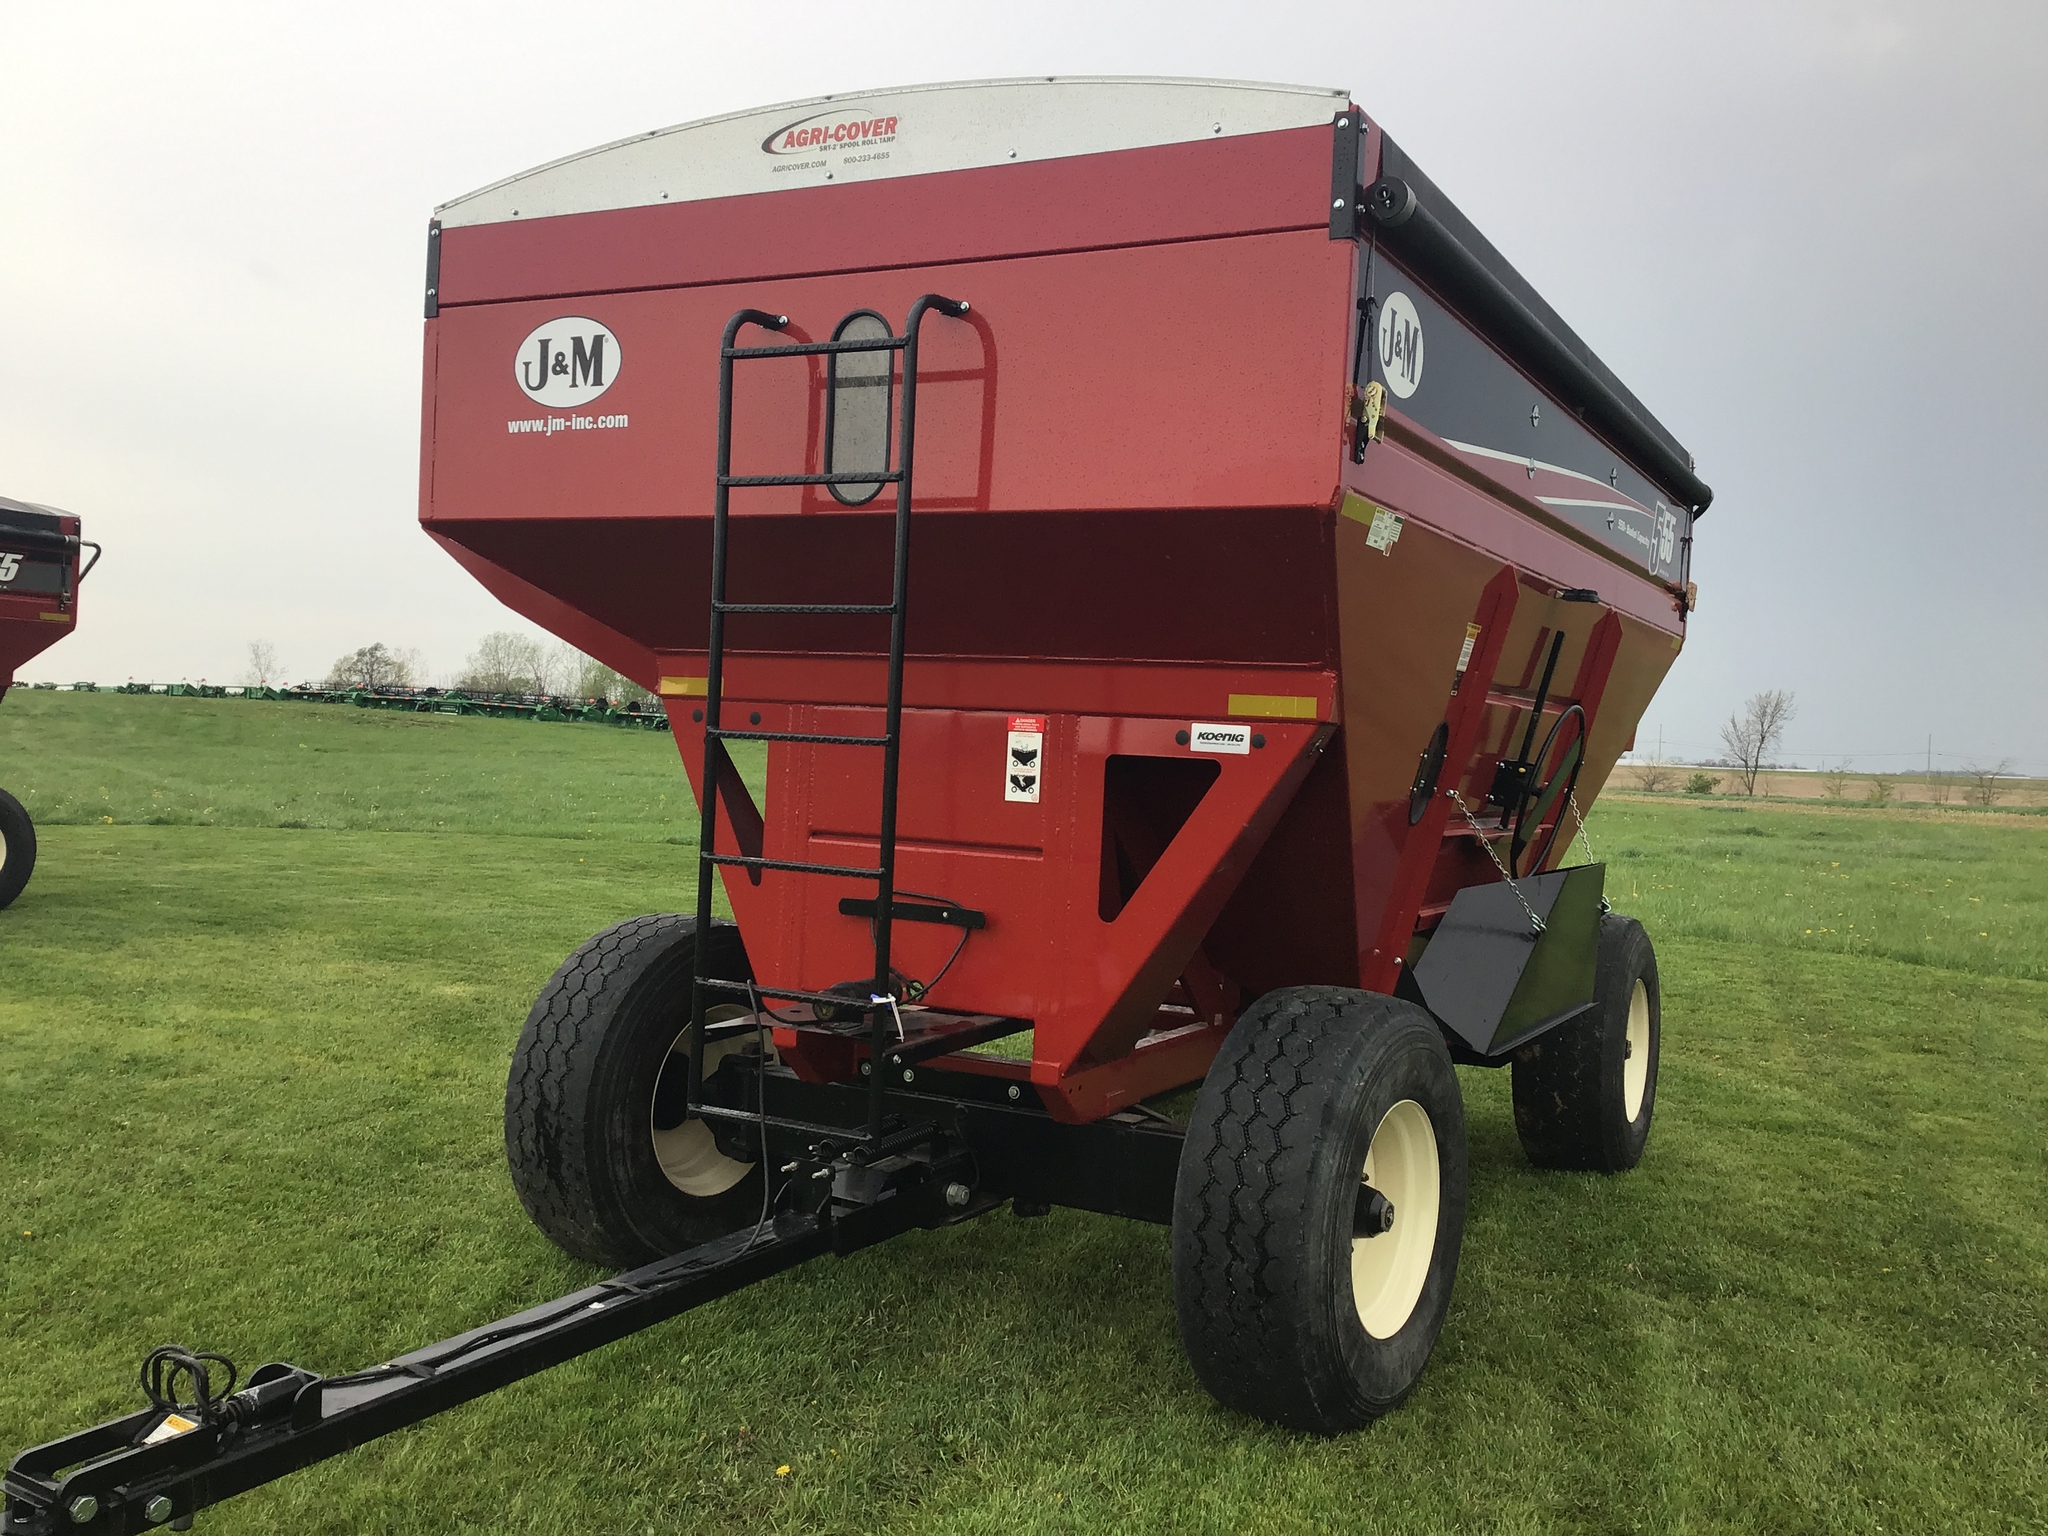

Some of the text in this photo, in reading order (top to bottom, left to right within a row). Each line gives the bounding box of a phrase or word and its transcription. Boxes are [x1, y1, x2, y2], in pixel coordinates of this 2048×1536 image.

[782, 116, 898, 149] AGRI-COVER
[839, 141, 860, 150] SPOOL
[879, 136, 896, 144] TARP
[772, 160, 827, 173] AGRICOVER.COM
[843, 151, 890, 165] 800-233-4655
[1383, 307, 1418, 385] J&M
[523, 334, 606, 391] J&M
[508, 413, 628, 436] www.jm-inc.com
